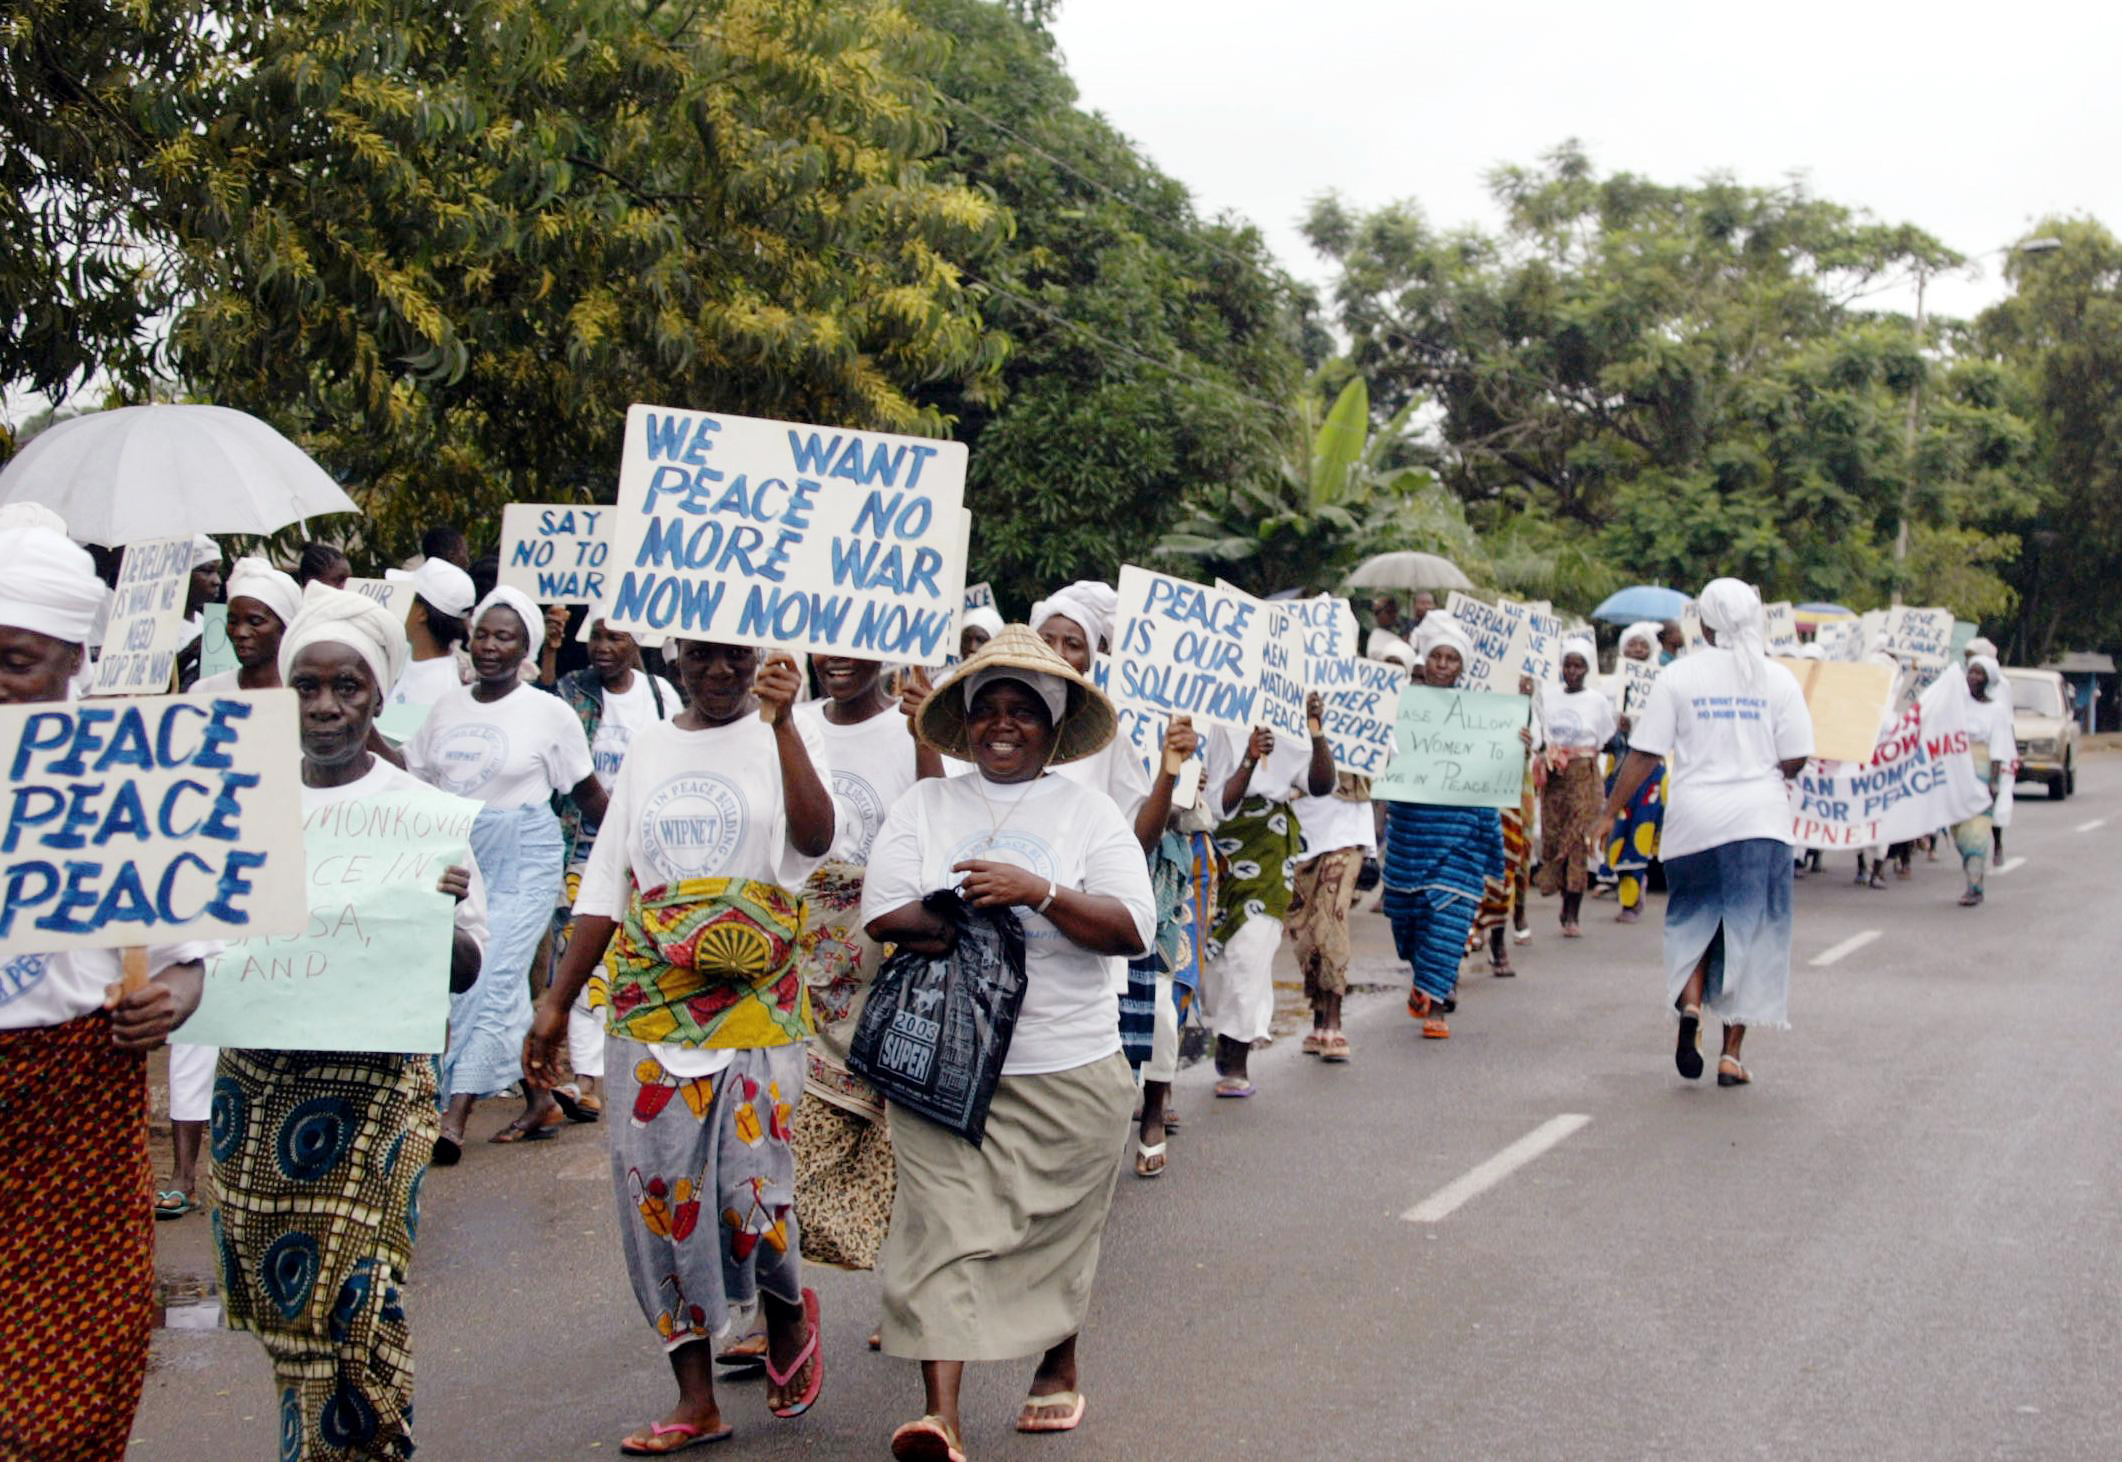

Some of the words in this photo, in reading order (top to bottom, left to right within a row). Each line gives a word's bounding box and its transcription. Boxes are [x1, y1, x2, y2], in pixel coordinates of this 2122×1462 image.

[646, 413, 722, 466] WE
[787, 429, 938, 489] WANT
[641, 466, 821, 530] PEACE
[852, 490, 932, 541] NO
[538, 510, 602, 536] SAY
[511, 540, 554, 568] NO
[576, 541, 608, 567] TO
[635, 516, 803, 583] MORE
[831, 536, 943, 599] WAR
[538, 571, 605, 599] WAR
[612, 571, 726, 632] NOW
[738, 584, 853, 647] NOW
[852, 599, 949, 657] NOW
[1143, 577, 1256, 641] PEACE
[1268, 612, 1290, 640] UP
[1121, 616, 1153, 656] IS
[1173, 632, 1244, 678] OUR
[1120, 658, 1258, 727] SOLUTION
[1259, 671, 1305, 709] NATION
[1359, 663, 1404, 694] ORK
[1262, 697, 1305, 739] PEACE
[1322, 708, 1394, 746] PEOPLE
[9, 699, 253, 783] PEACE
[1411, 730, 1475, 755] WOMEN
[671, 782, 718, 797] PEACE
[1801, 793, 1848, 821] FOR
[1, 769, 261, 855] PEACE
[1792, 816, 1882, 845] IPNET
[659, 819, 718, 845] WIPNET
[0, 850, 268, 940] PEACE
[240, 951, 328, 982] AND
[894, 1013, 938, 1039] 2003
[882, 1034, 930, 1079] SUPER
